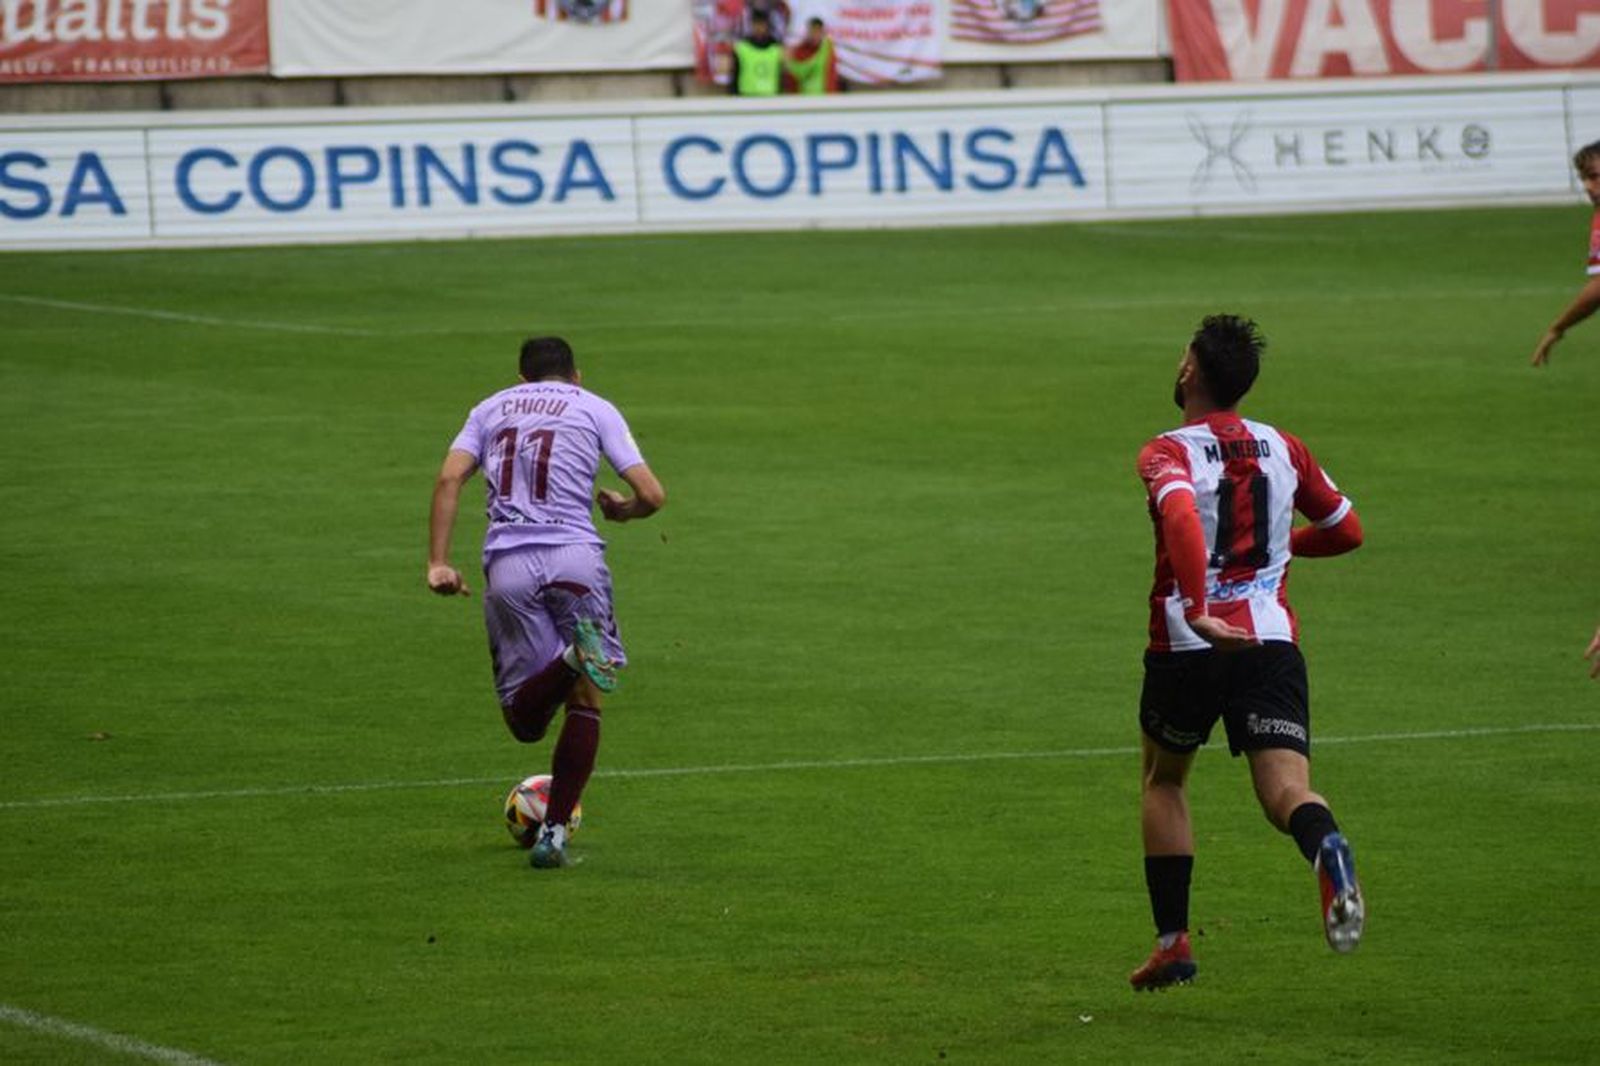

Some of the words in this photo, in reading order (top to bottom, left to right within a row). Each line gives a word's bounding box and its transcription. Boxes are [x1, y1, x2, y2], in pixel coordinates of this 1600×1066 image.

[0, 150, 128, 220] SA
[174, 138, 616, 215] COPINSA
[662, 127, 1087, 201] COPINSA
[489, 426, 556, 504] 11
[1209, 475, 1271, 569] 11
